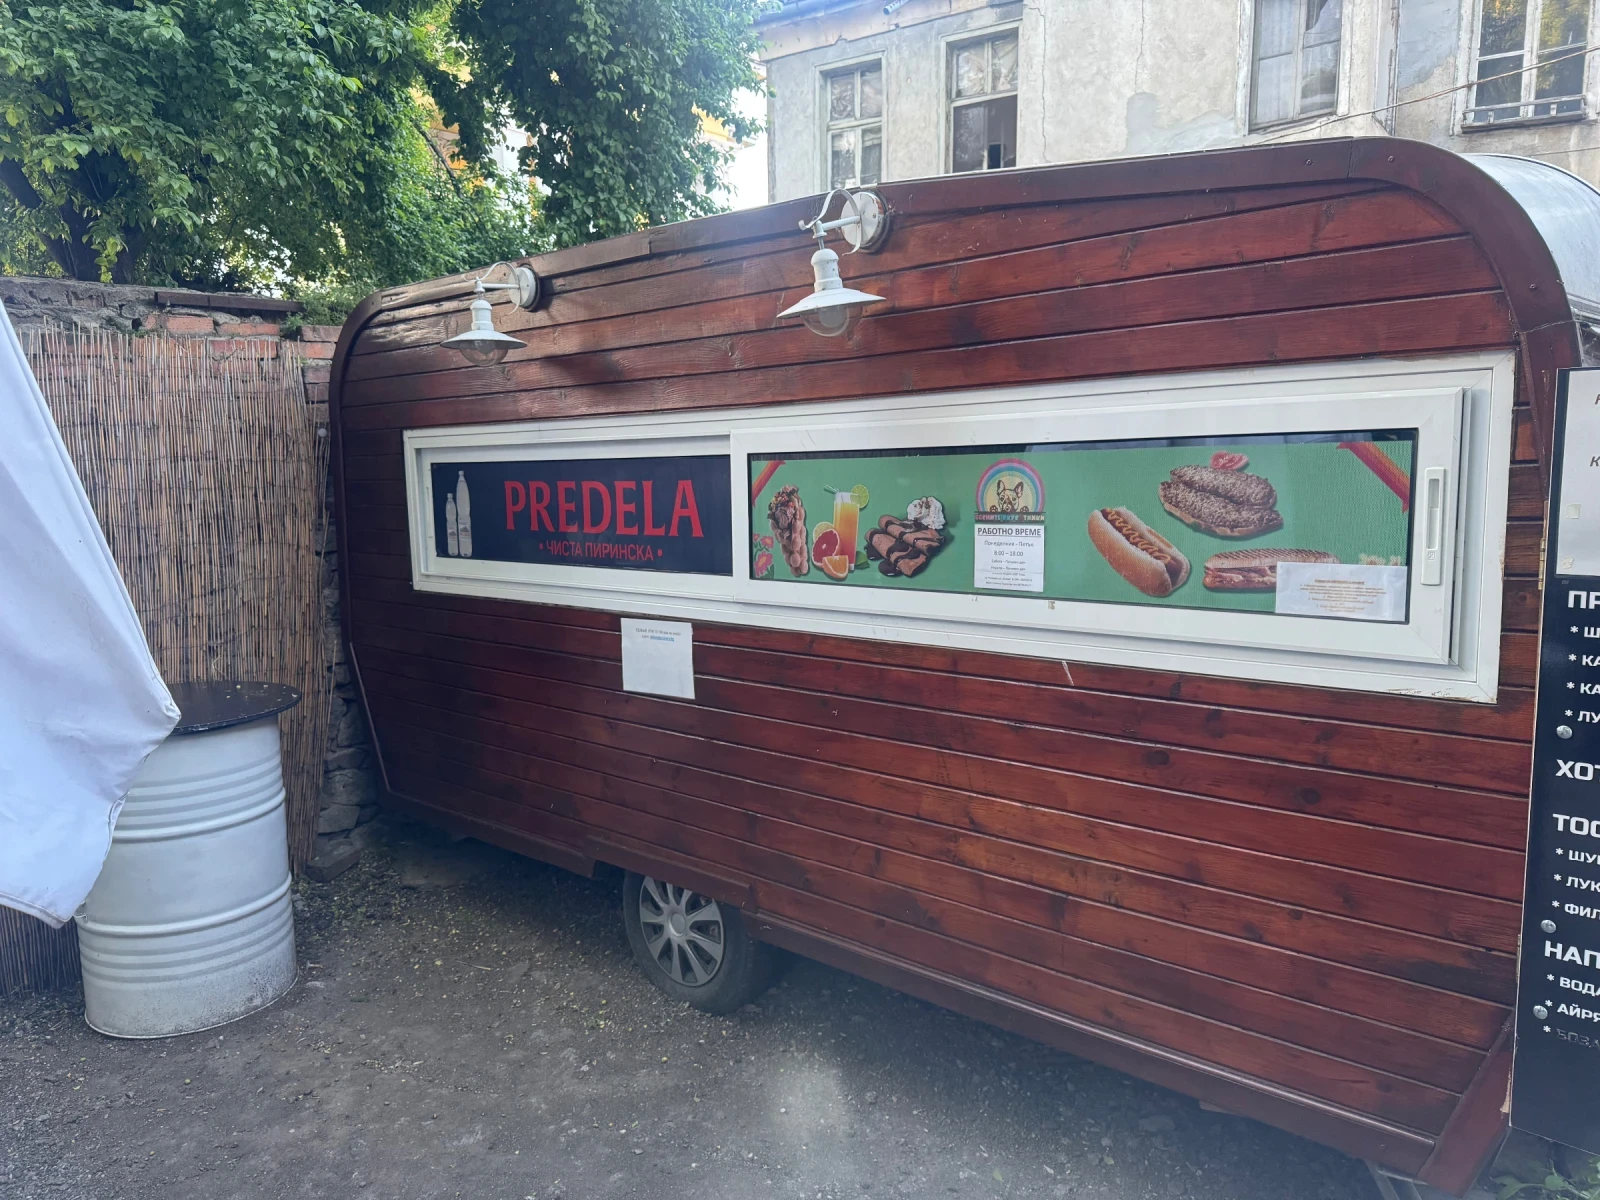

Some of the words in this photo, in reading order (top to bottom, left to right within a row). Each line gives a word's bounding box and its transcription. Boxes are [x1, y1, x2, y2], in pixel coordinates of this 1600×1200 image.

[504, 480, 705, 538] PREDELA
[977, 527, 1014, 535] РАБОТНО
[546, 542, 583, 558] ЧИСТА
[585, 542, 654, 562] ПИРИНСКА
[1568, 849, 1600, 865] ШУ
[1566, 876, 1600, 892] ЛУК
[1544, 940, 1600, 970] НАП
